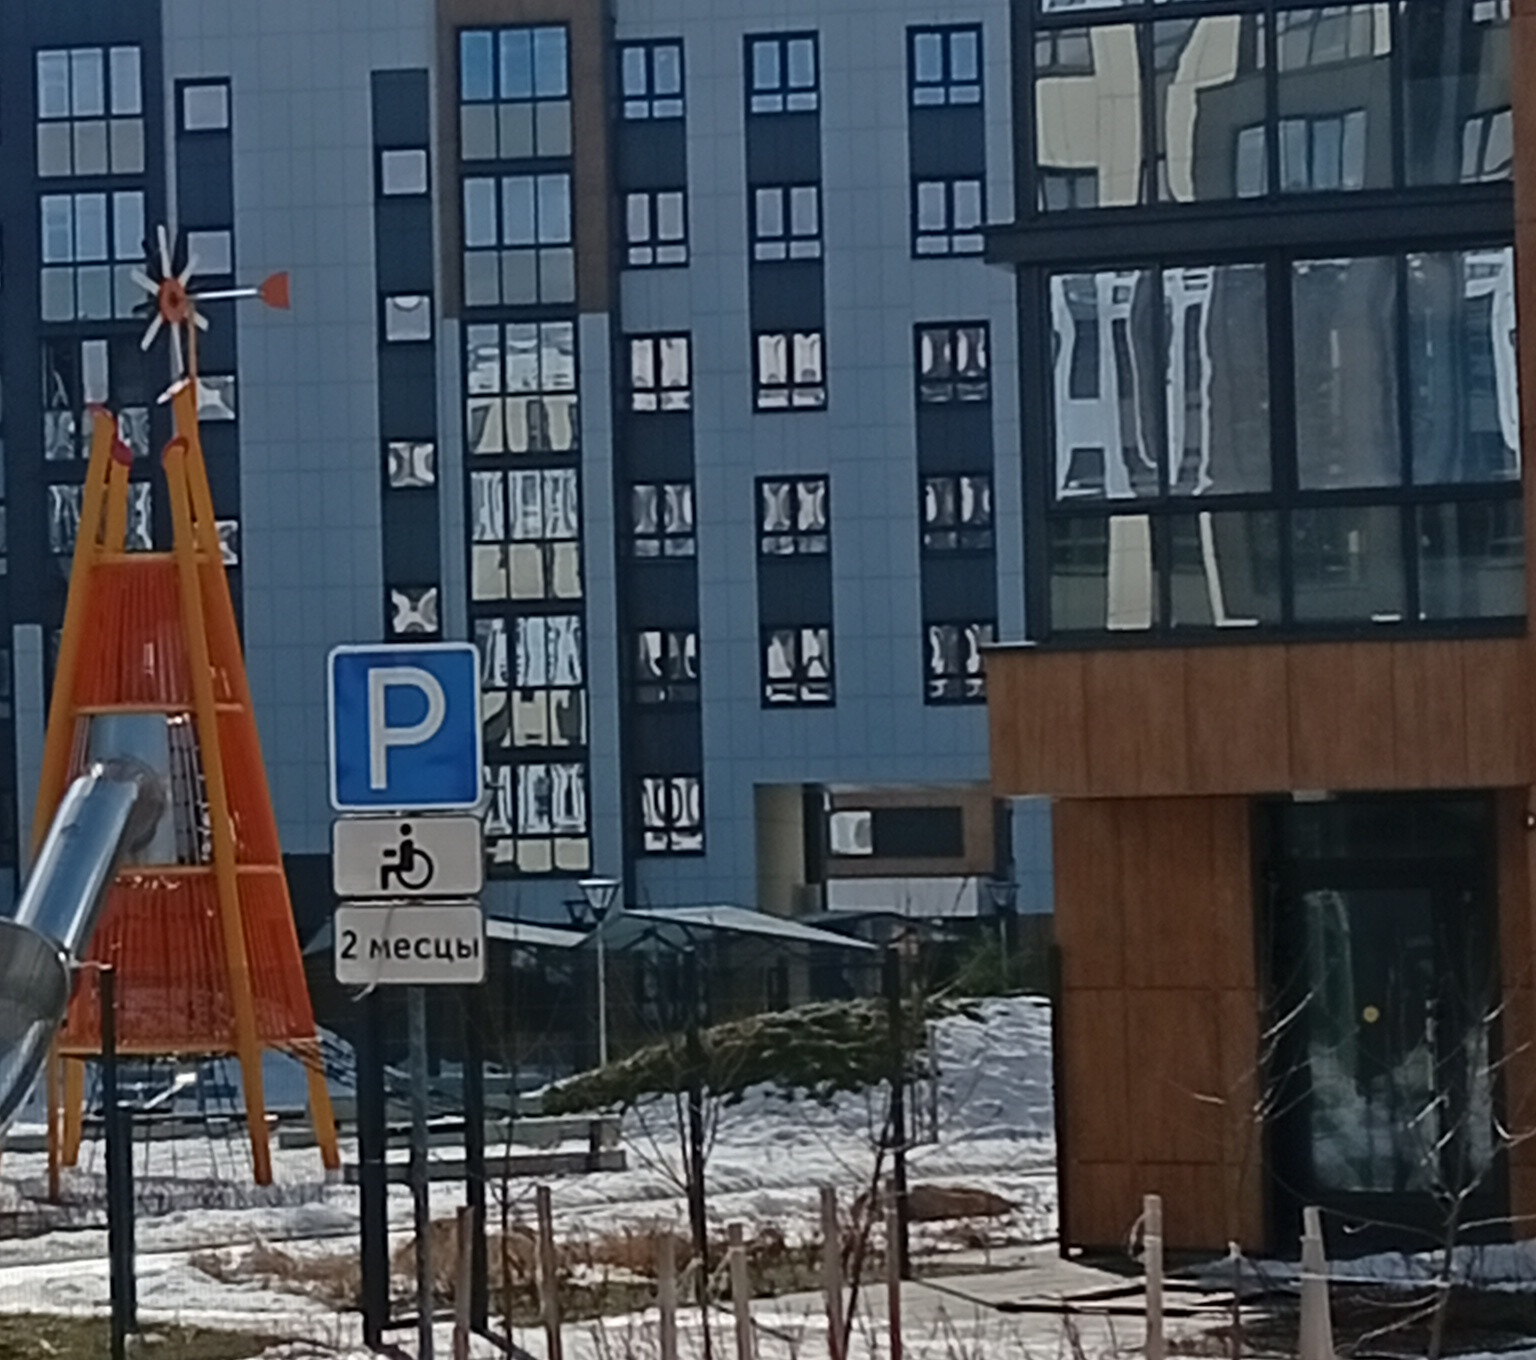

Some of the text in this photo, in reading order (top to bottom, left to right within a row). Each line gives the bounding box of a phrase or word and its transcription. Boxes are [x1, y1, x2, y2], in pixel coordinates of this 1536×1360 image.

[367, 666, 446, 789] P
[341, 930, 479, 963] 2 месцы
